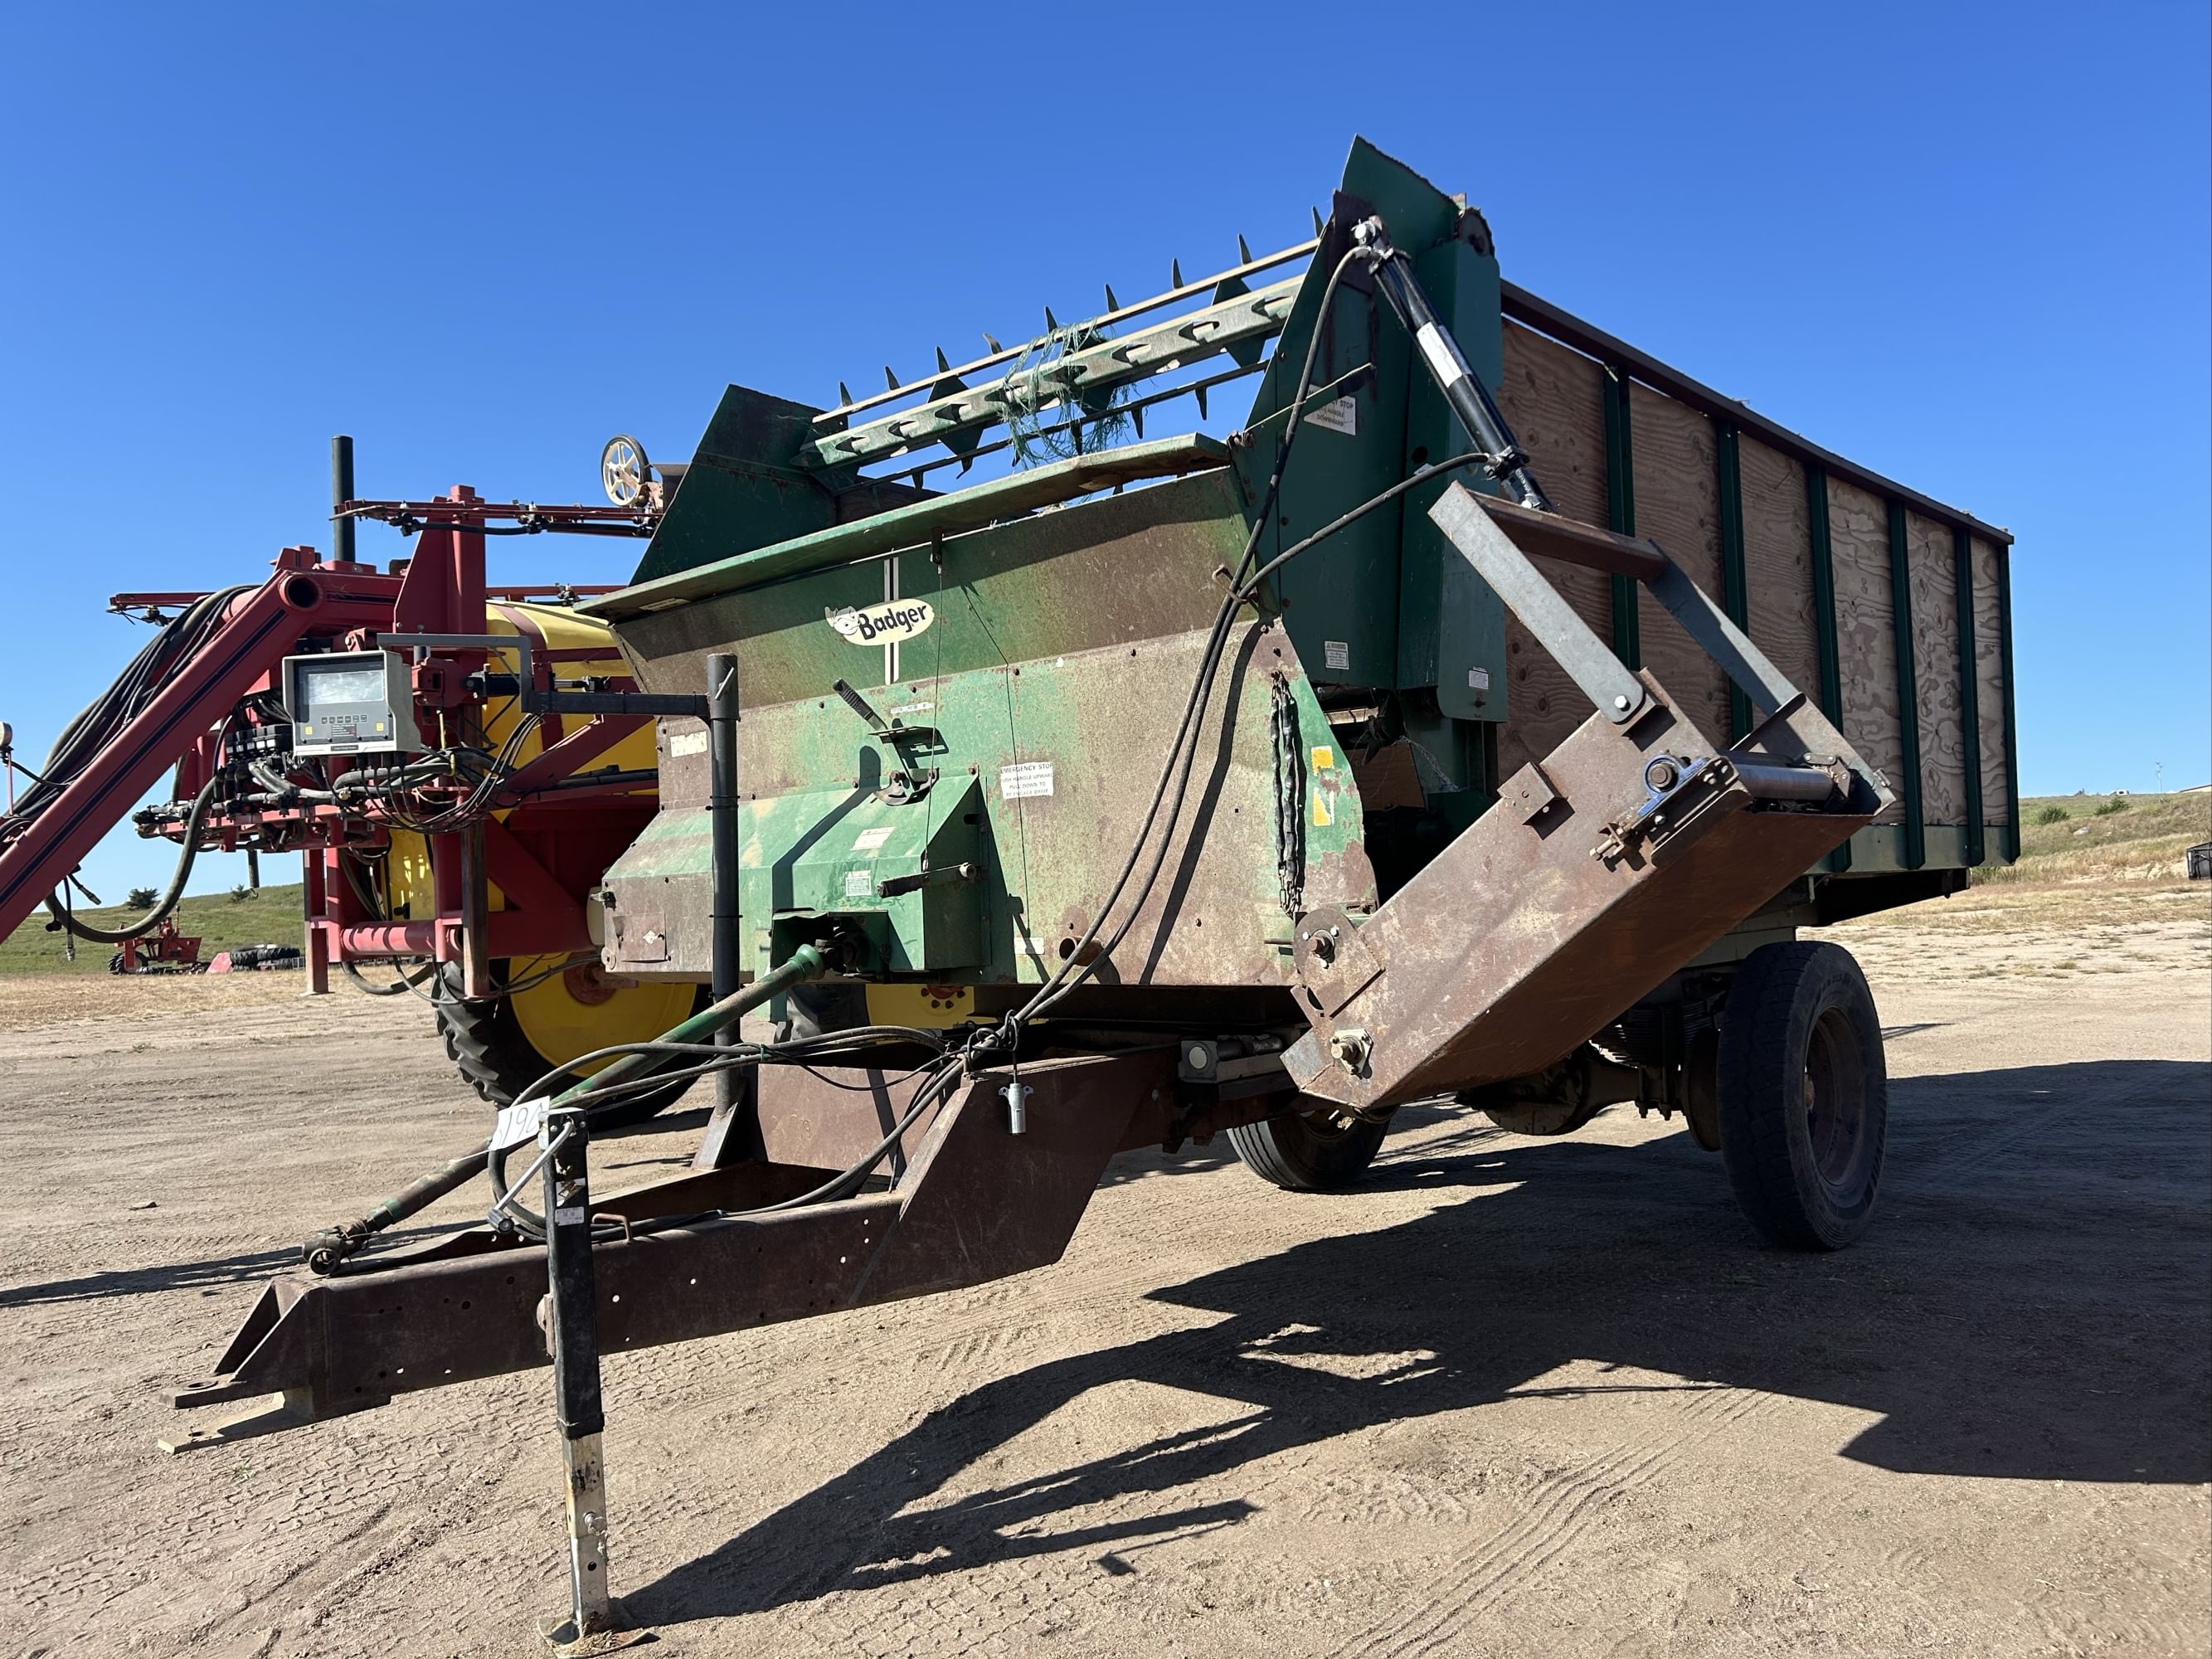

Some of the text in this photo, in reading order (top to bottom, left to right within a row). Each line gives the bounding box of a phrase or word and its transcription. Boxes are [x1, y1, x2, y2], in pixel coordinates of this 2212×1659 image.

[1339, 400, 1354, 411] STOP
[858, 604, 926, 640] Badger
[1000, 765, 1036, 774] EMERGENCY
